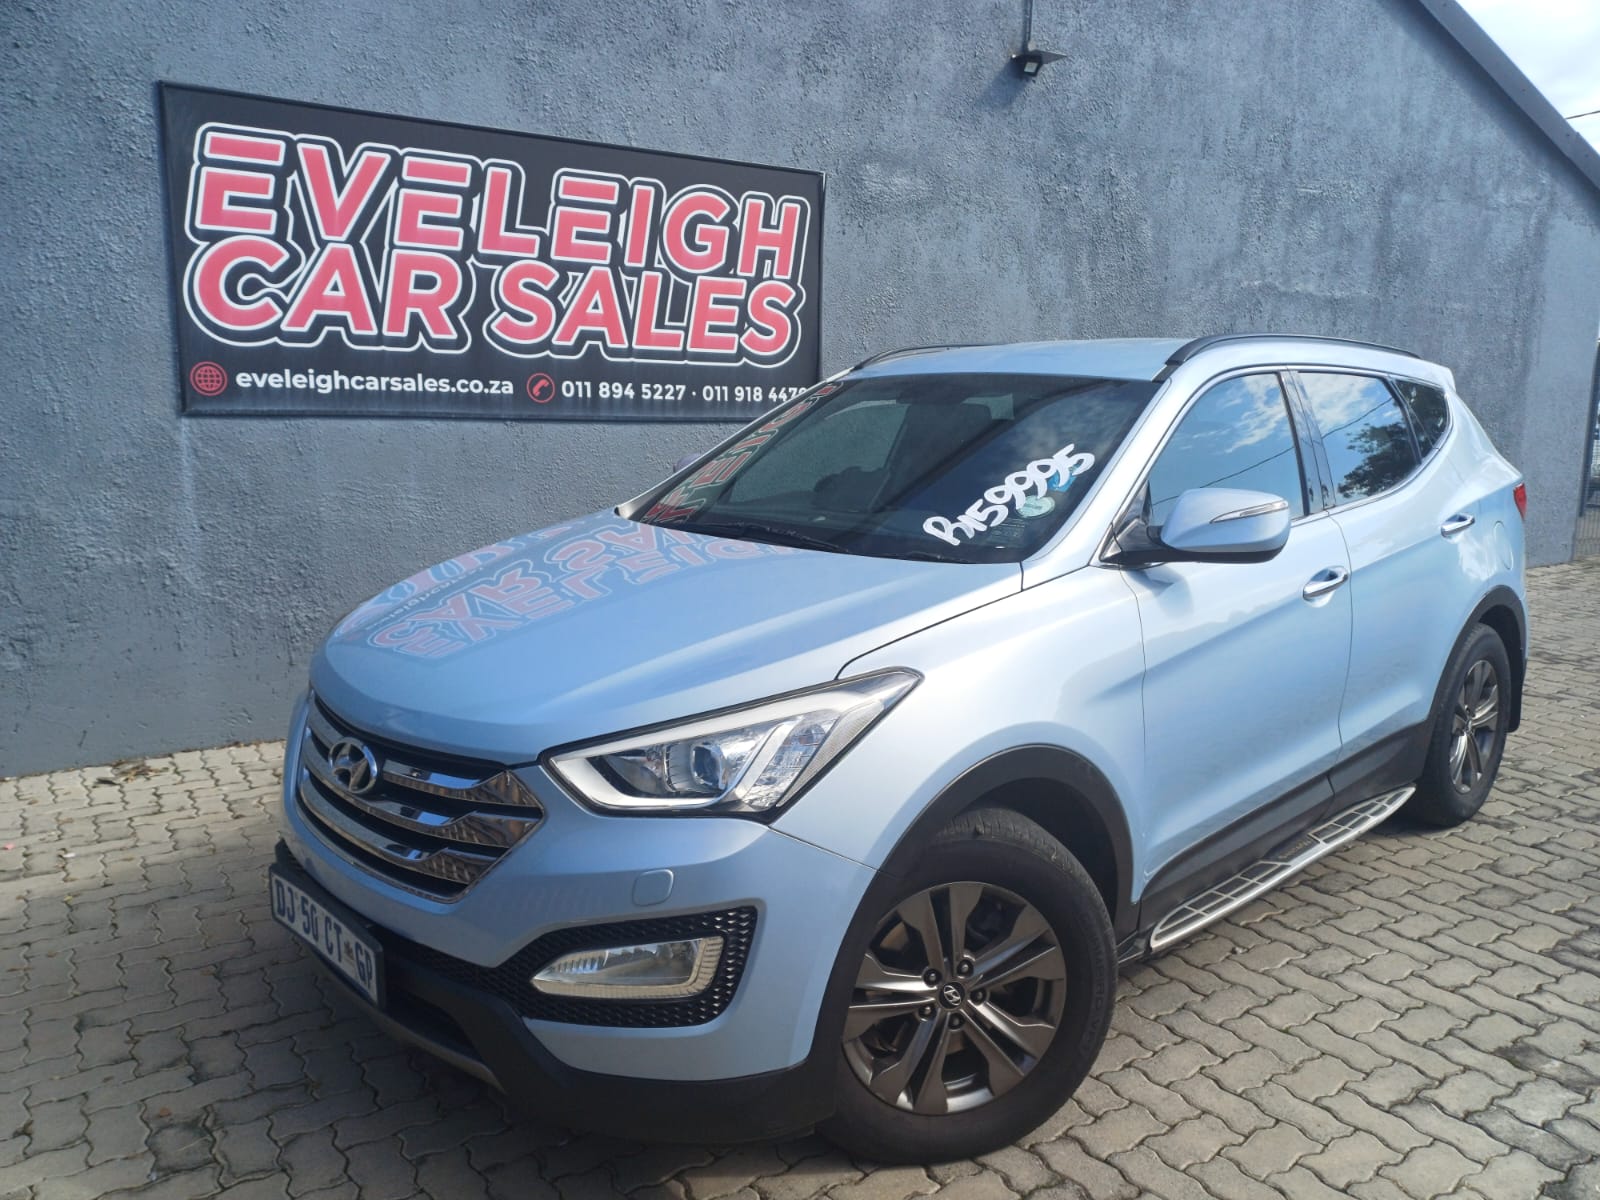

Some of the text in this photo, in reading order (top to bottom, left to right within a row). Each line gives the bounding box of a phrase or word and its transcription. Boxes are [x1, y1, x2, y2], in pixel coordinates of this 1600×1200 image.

[193, 125, 808, 280] EVELEIGH
[190, 237, 802, 360] CAR SALES
[235, 369, 514, 394] eveleighcarsales.co.za
[561, 381, 592, 398] 011
[599, 382, 635, 399] 894
[641, 384, 686, 401] 5227
[702, 385, 729, 401] 011
[735, 387, 763, 402] 918
[275, 879, 296, 924] DJ
[324, 915, 343, 963] CT
[354, 941, 373, 990] GP
